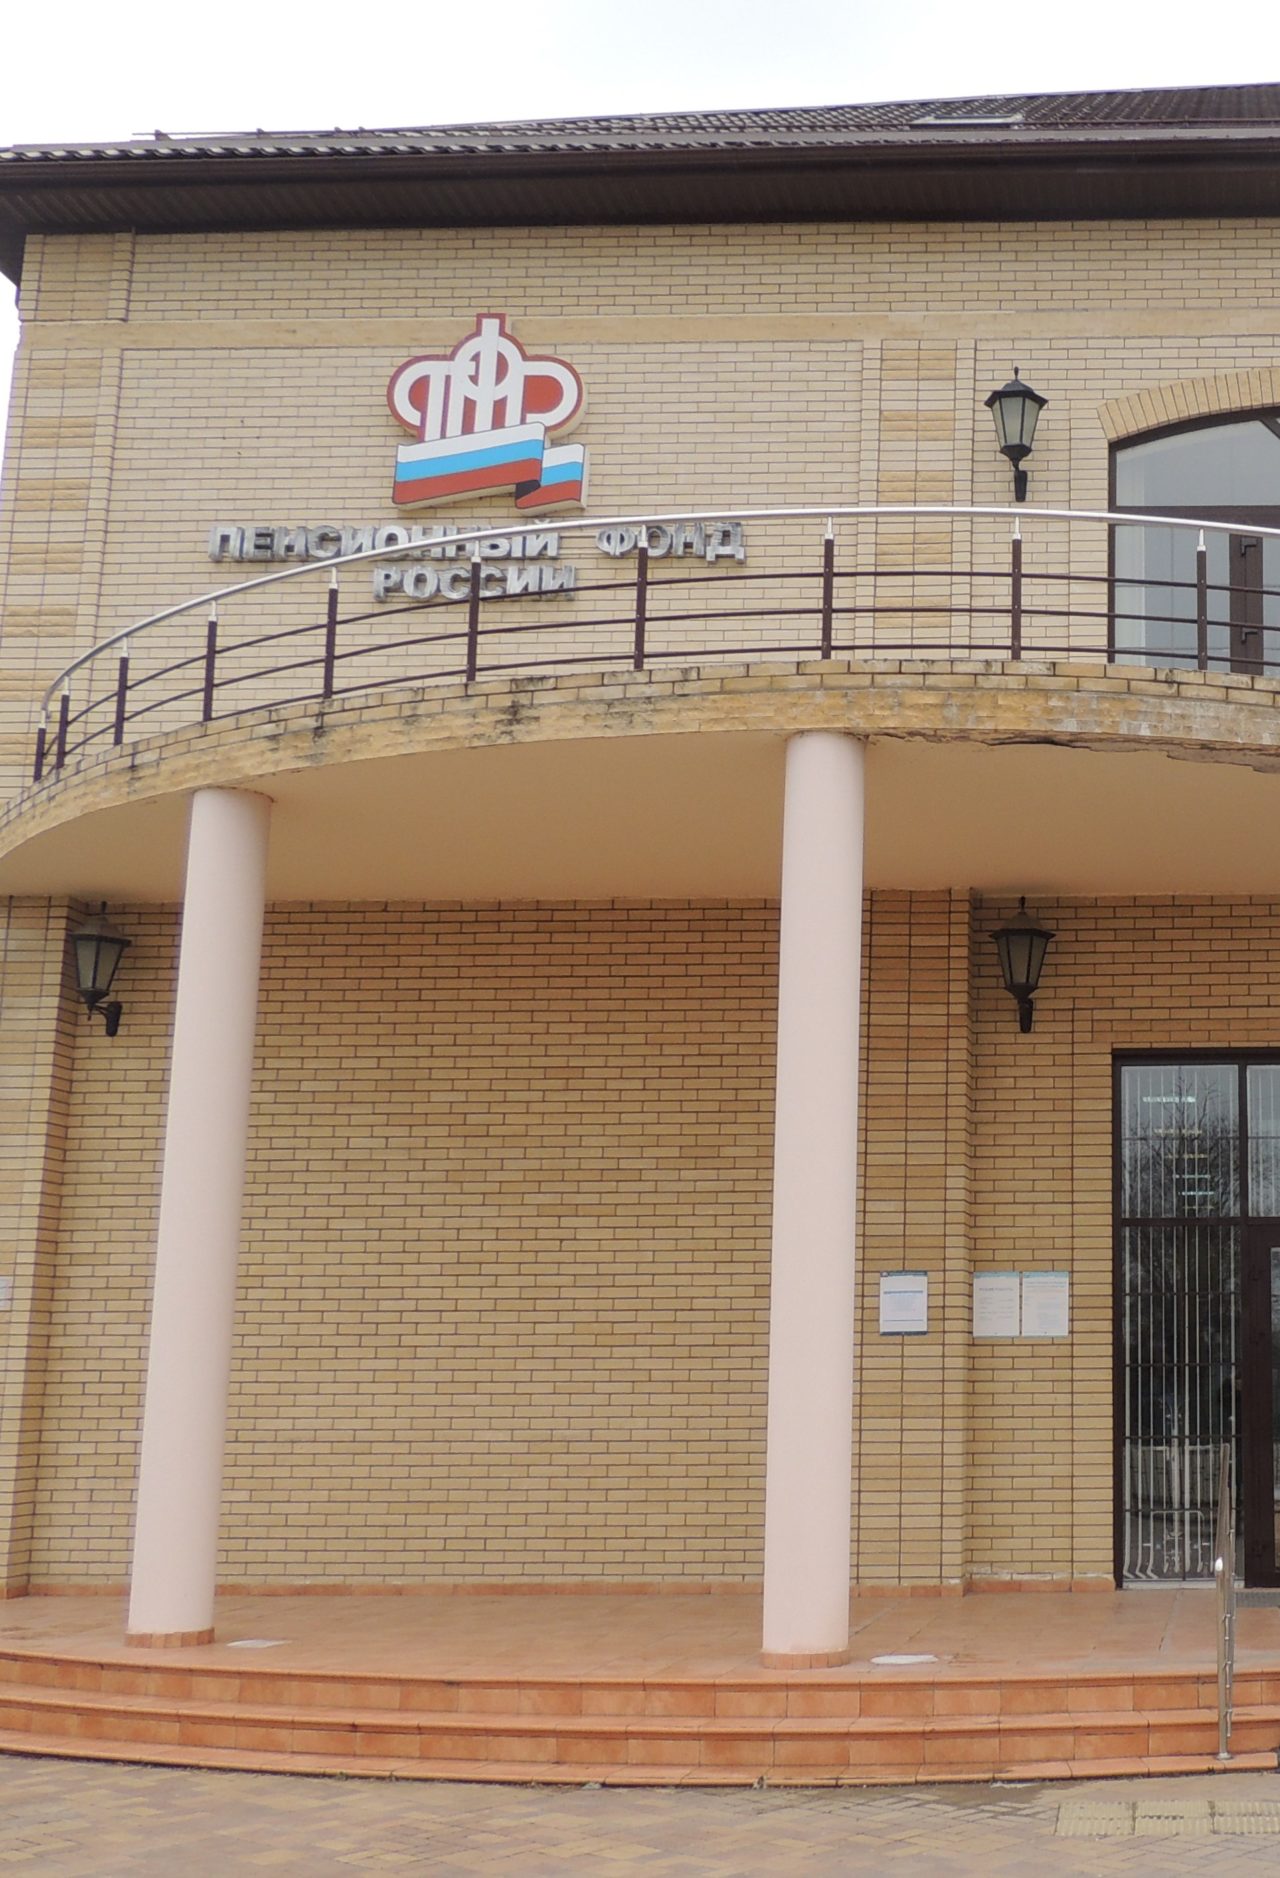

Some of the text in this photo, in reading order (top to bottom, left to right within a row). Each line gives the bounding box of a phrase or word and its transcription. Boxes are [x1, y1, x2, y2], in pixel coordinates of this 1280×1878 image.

[209, 518, 746, 565] ПЕНСИОННЫЙ ФОНД
[373, 564, 576, 603] РОССИИ
